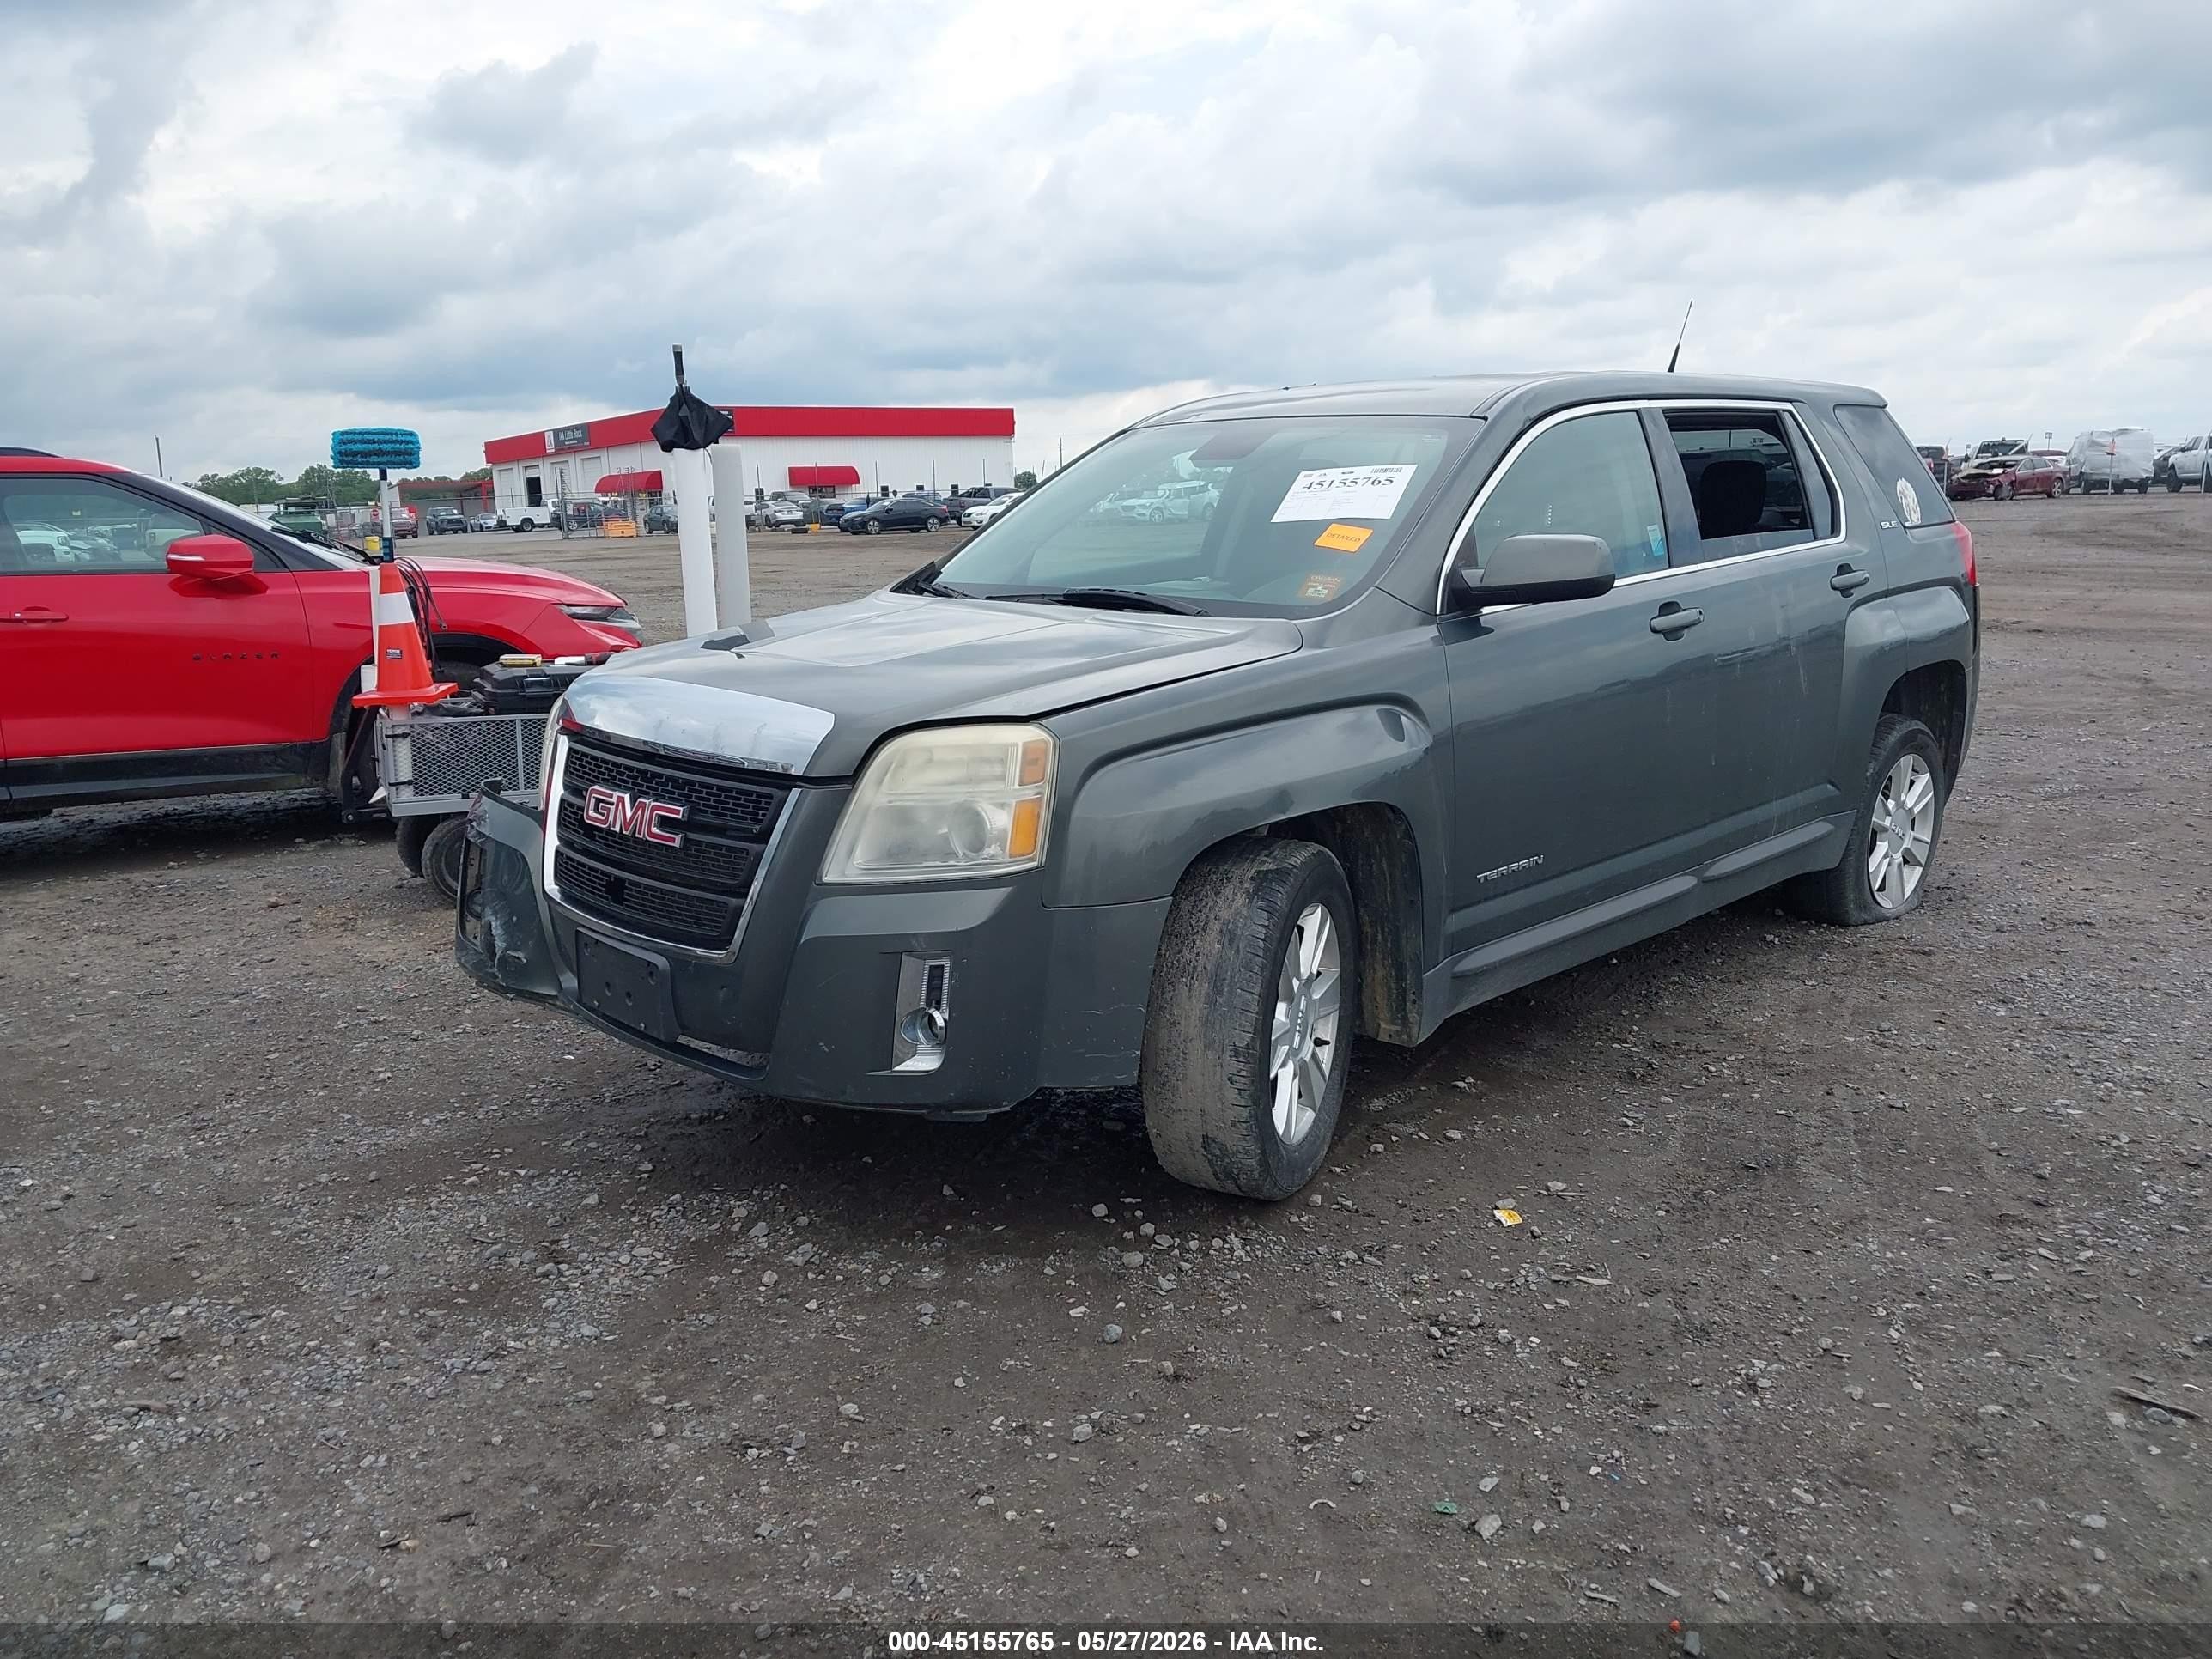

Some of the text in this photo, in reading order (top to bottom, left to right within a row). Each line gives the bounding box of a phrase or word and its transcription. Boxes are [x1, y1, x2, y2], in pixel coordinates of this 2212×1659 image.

[1302, 475, 1396, 491] 45155765
[1880, 520, 1899, 530] SLE
[583, 785, 686, 848] GMC
[1476, 854, 1545, 884] TERRAIN
